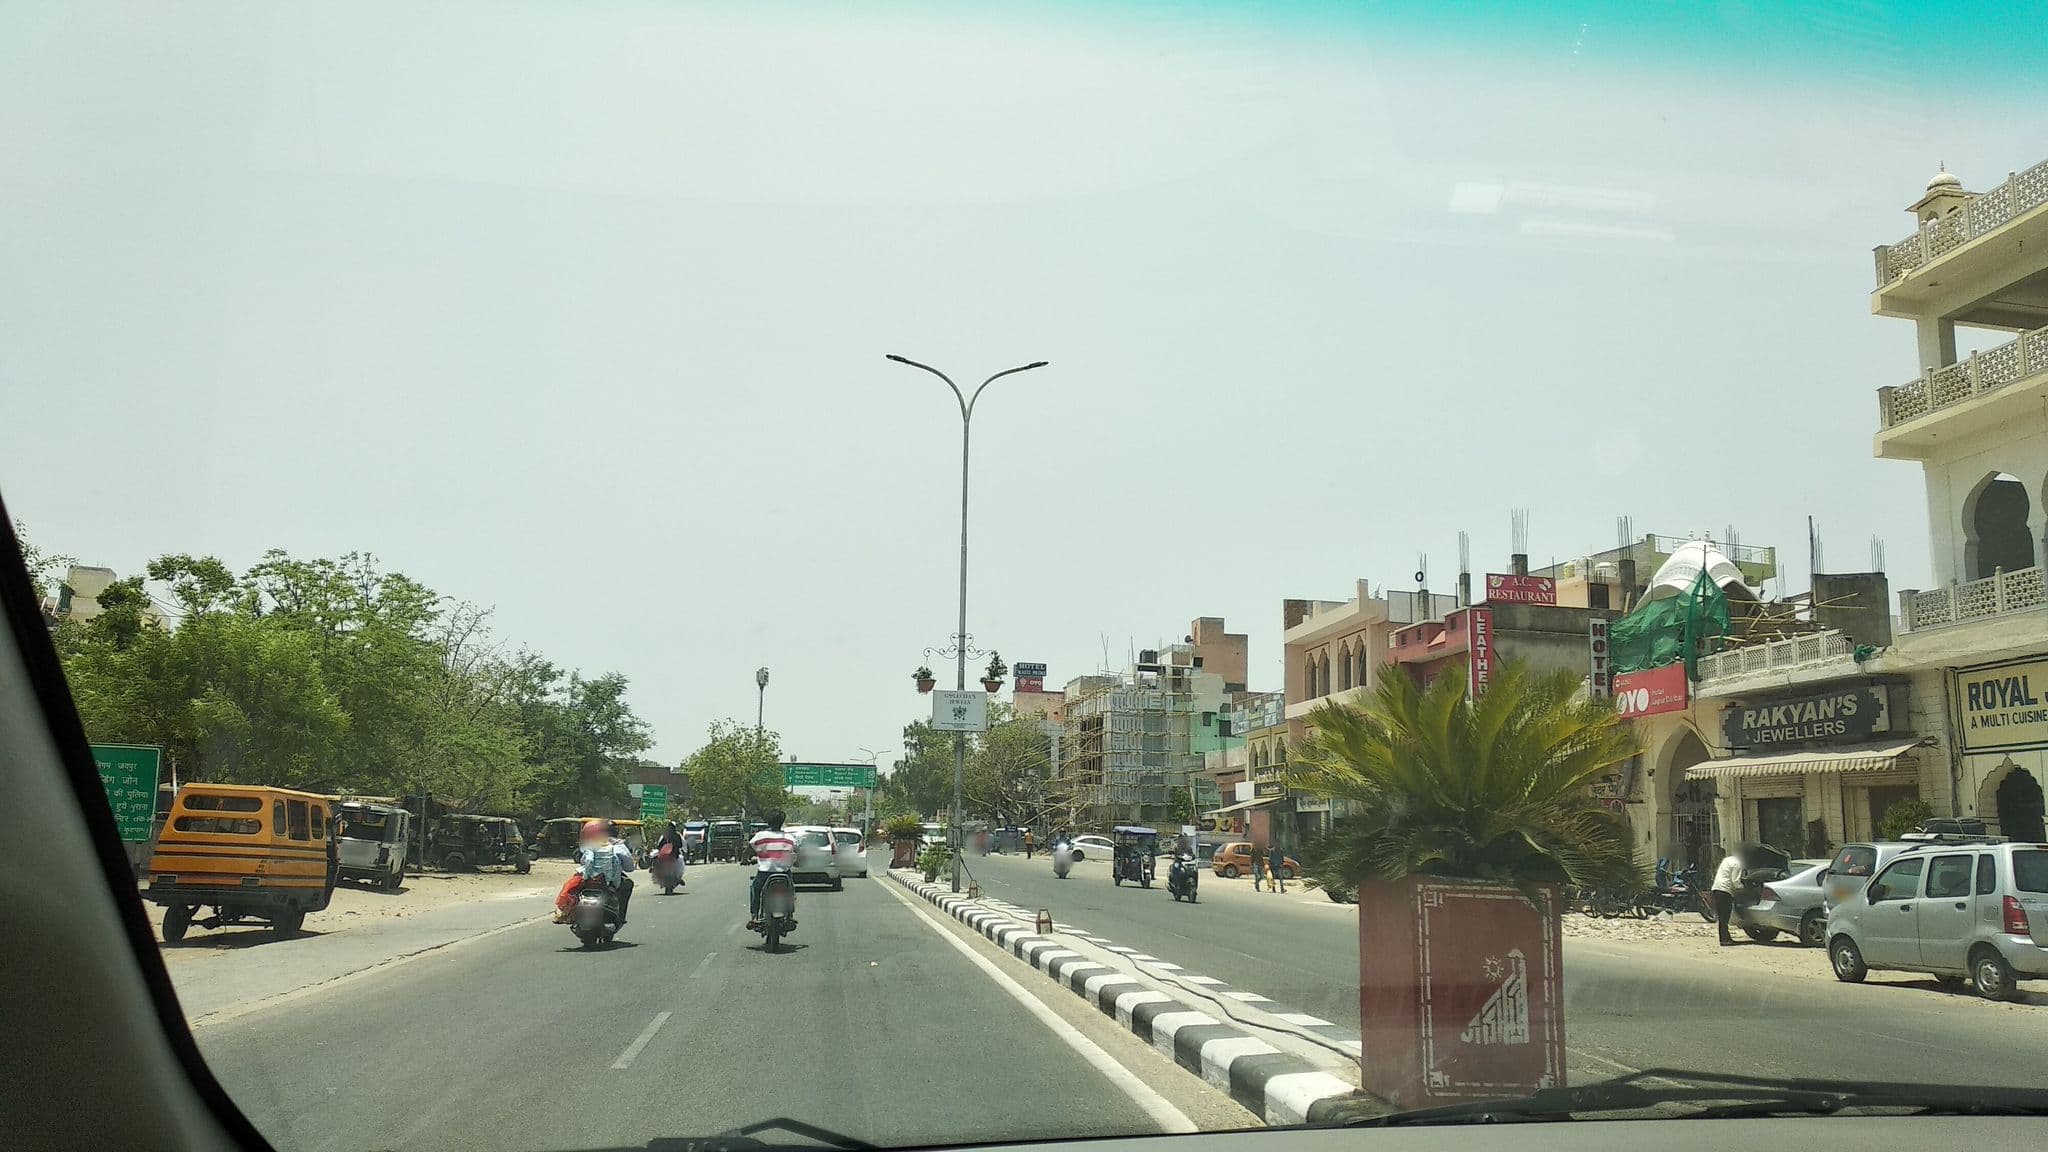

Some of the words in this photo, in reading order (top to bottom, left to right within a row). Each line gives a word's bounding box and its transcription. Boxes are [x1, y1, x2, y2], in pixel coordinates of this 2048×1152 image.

[1511, 576, 1532, 587] A.C.
[1488, 589, 1556, 603] RESTAURANT
[1616, 687, 1649, 715] OYO
[1967, 675, 2038, 711] ROYAL
[1743, 694, 1858, 730] RAKYAN'S
[1971, 716, 1978, 729] A
[1980, 713, 2010, 728] MULTI
[2012, 709, 2048, 725] CUISINE
[1753, 720, 1846, 744] JEWELLERS
